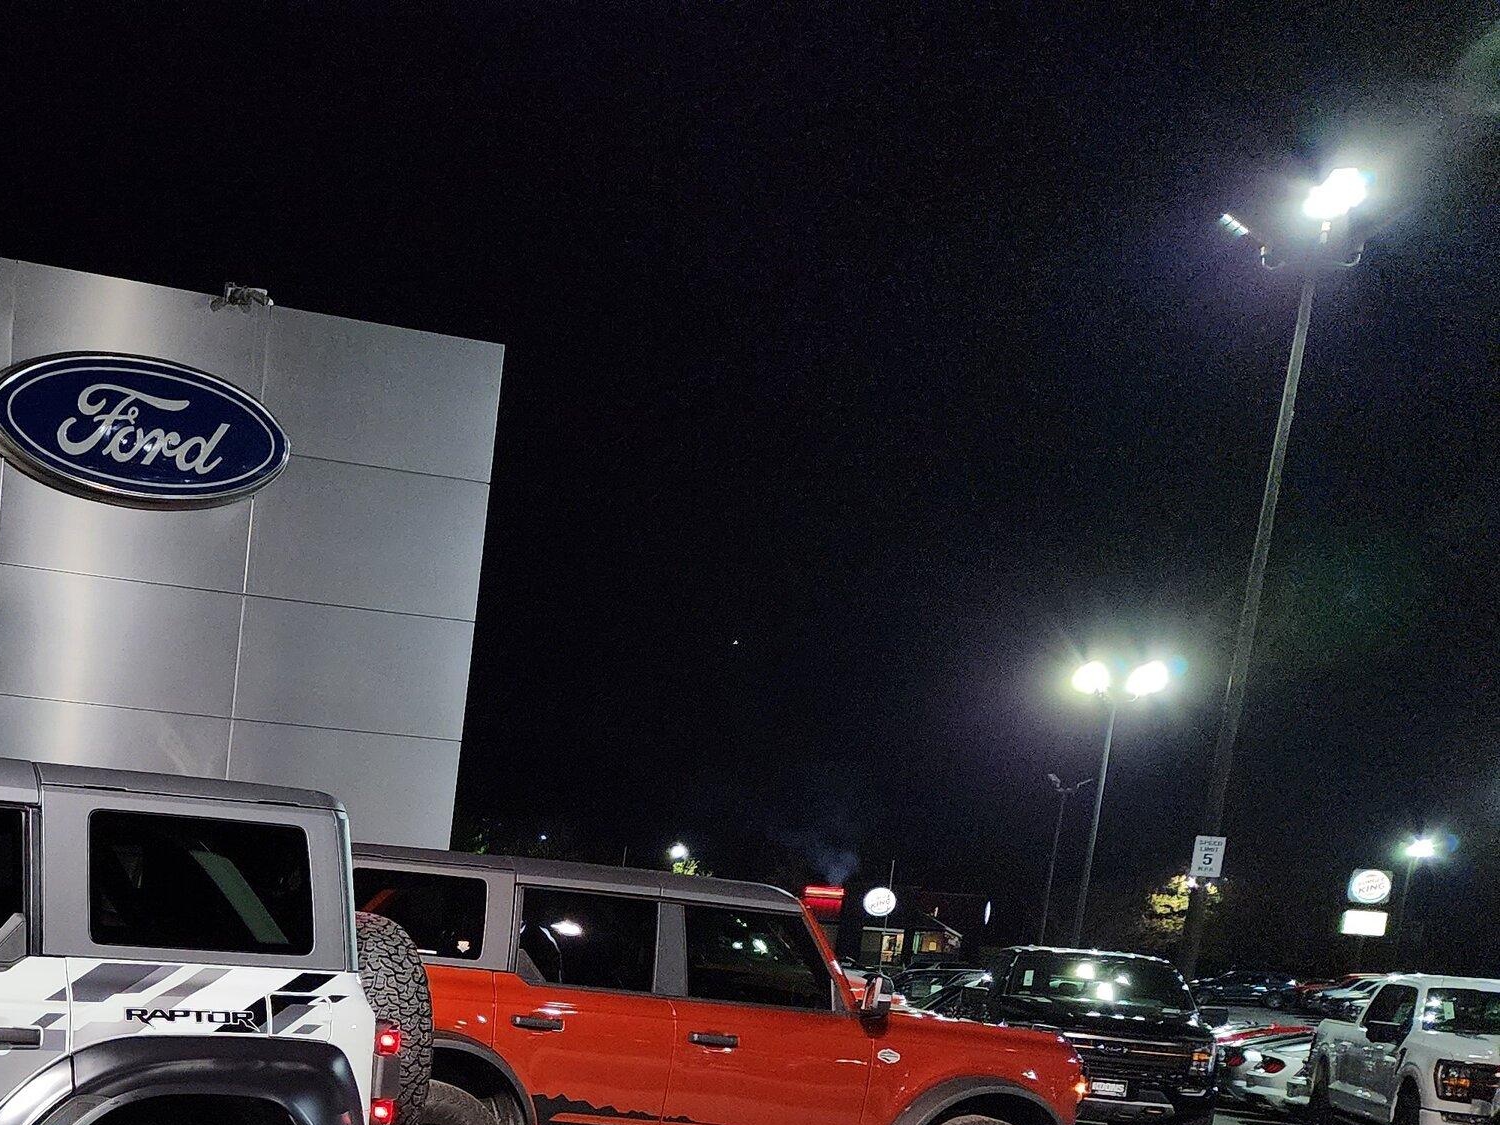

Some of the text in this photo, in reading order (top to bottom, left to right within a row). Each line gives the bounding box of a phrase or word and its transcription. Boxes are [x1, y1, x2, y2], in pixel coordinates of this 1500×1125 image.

[56, 383, 231, 475] Ford
[1202, 853, 1214, 866] 5
[1358, 883, 1385, 894] KING
[125, 1008, 261, 1033] RAPTOR
